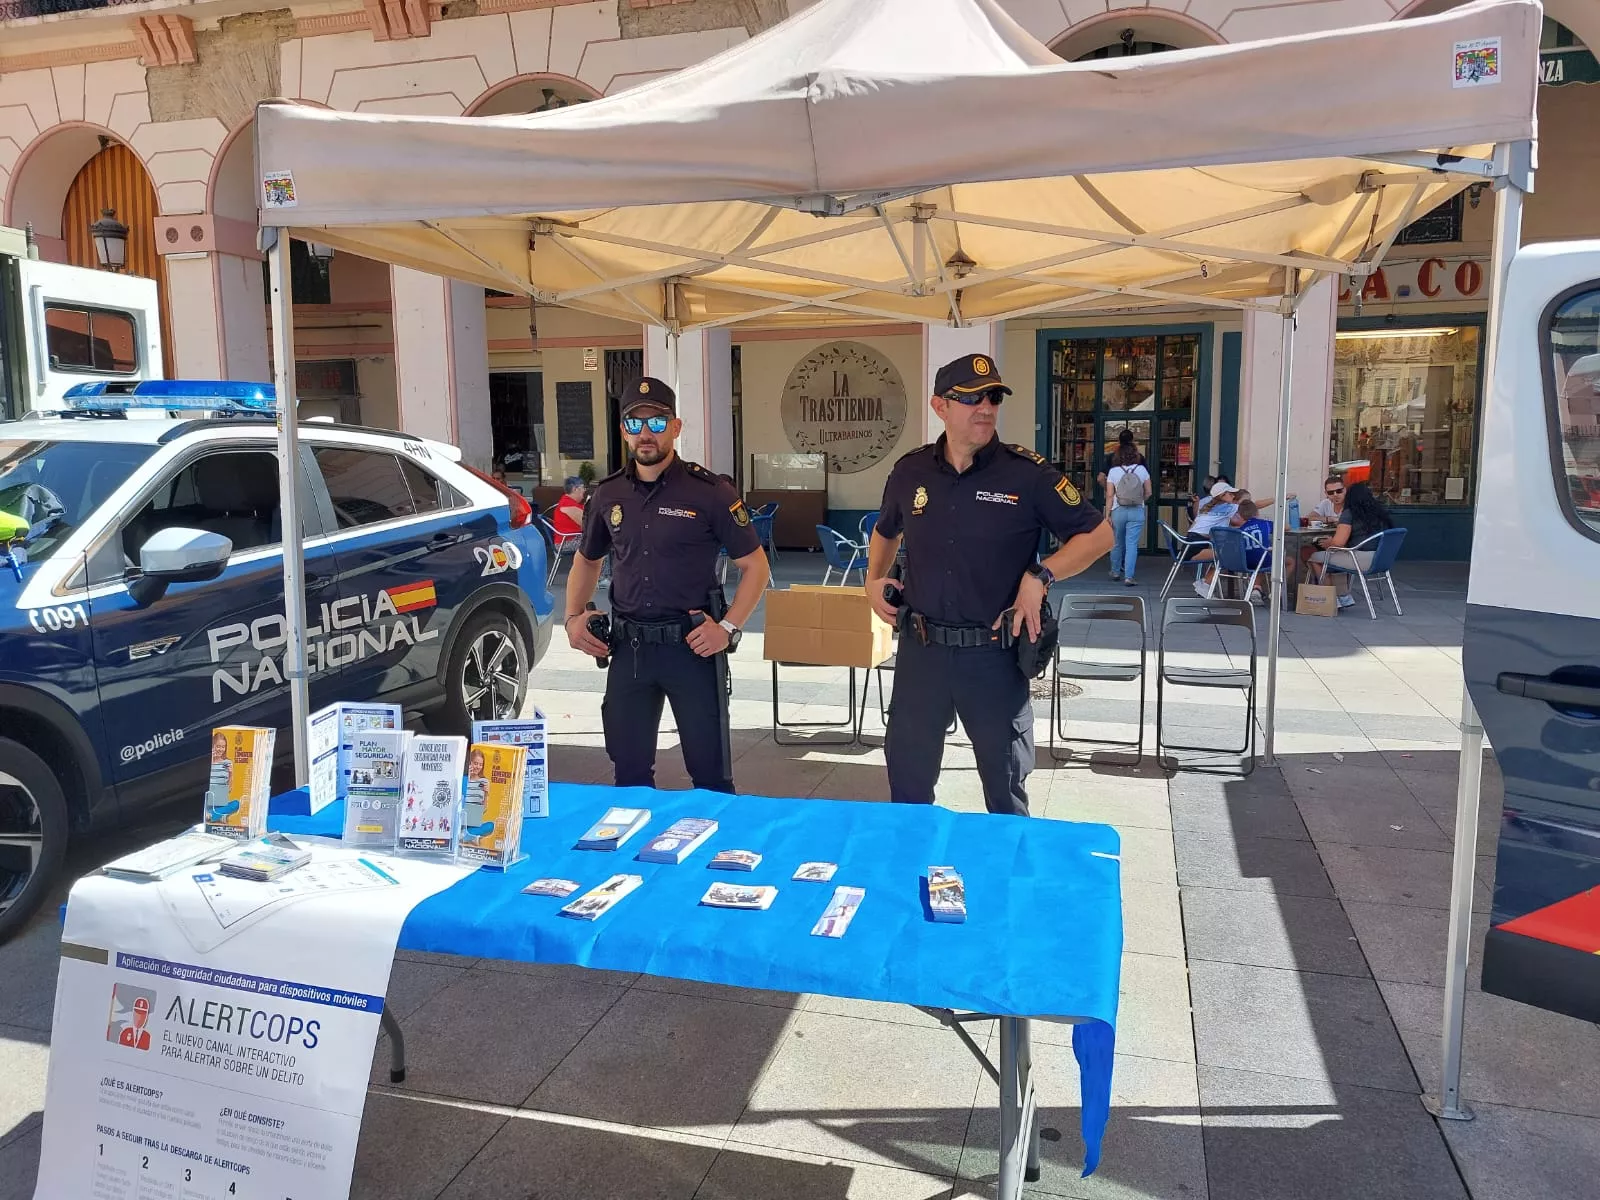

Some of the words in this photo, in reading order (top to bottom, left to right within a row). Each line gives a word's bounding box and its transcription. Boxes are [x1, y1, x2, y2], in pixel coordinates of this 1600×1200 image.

[832, 371, 850, 397] LA
[800, 396, 884, 422] TRASTIENDA
[820, 429, 873, 445] ULTRABARINOS
[403, 441, 433, 460] 4HN
[975, 496, 1017, 505] NACIONAL
[1243, 529, 1263, 550] 10
[473, 541, 523, 577] 200
[42, 603, 90, 631] 091
[212, 616, 439, 704] NACIONAL
[119, 728, 184, 761] @policia
[121, 956, 160, 972] Aplicación
[161, 963, 171, 974] de
[172, 966, 213, 982] seguridad
[214, 973, 256, 989] ciudadana
[258, 982, 278, 993] para
[280, 984, 331, 1002] dispositivos
[333, 993, 368, 1008] móviles
[165, 995, 321, 1049] ALERTCOPS
[163, 1030, 173, 1042] EL
[175, 1032, 204, 1049] NUEVO
[205, 1039, 234, 1056] CANAL
[236, 1046, 296, 1068] INTERACTIVO
[161, 1044, 183, 1060] PARA
[185, 1050, 221, 1071] ALERTAR
[223, 1058, 253, 1076] SOBRE
[255, 1064, 269, 1078] UN
[271, 1067, 304, 1086] DELITO
[116, 1081, 125, 1090] ES
[125, 1083, 164, 1100] ALERTCOPS?
[219, 1107, 233, 1118] ¿EN
[233, 1110, 247, 1121] QUÉ
[248, 1113, 285, 1130] CONSISTE?
[96, 1124, 115, 1137] PASOS
[115, 1130, 121, 1139] A
[121, 1131, 143, 1145] SEGUIR
[144, 1137, 160, 1150] TRAS
[160, 1142, 169, 1152] LA
[170, 1144, 203, 1161] DESCARGA
[204, 1154, 213, 1165] DE
[213, 1157, 251, 1175] ALERTCOPS
[99, 1143, 104, 1156] 1
[142, 1156, 149, 1169] 2
[184, 1168, 192, 1182] 3
[229, 1182, 236, 1196] 4
